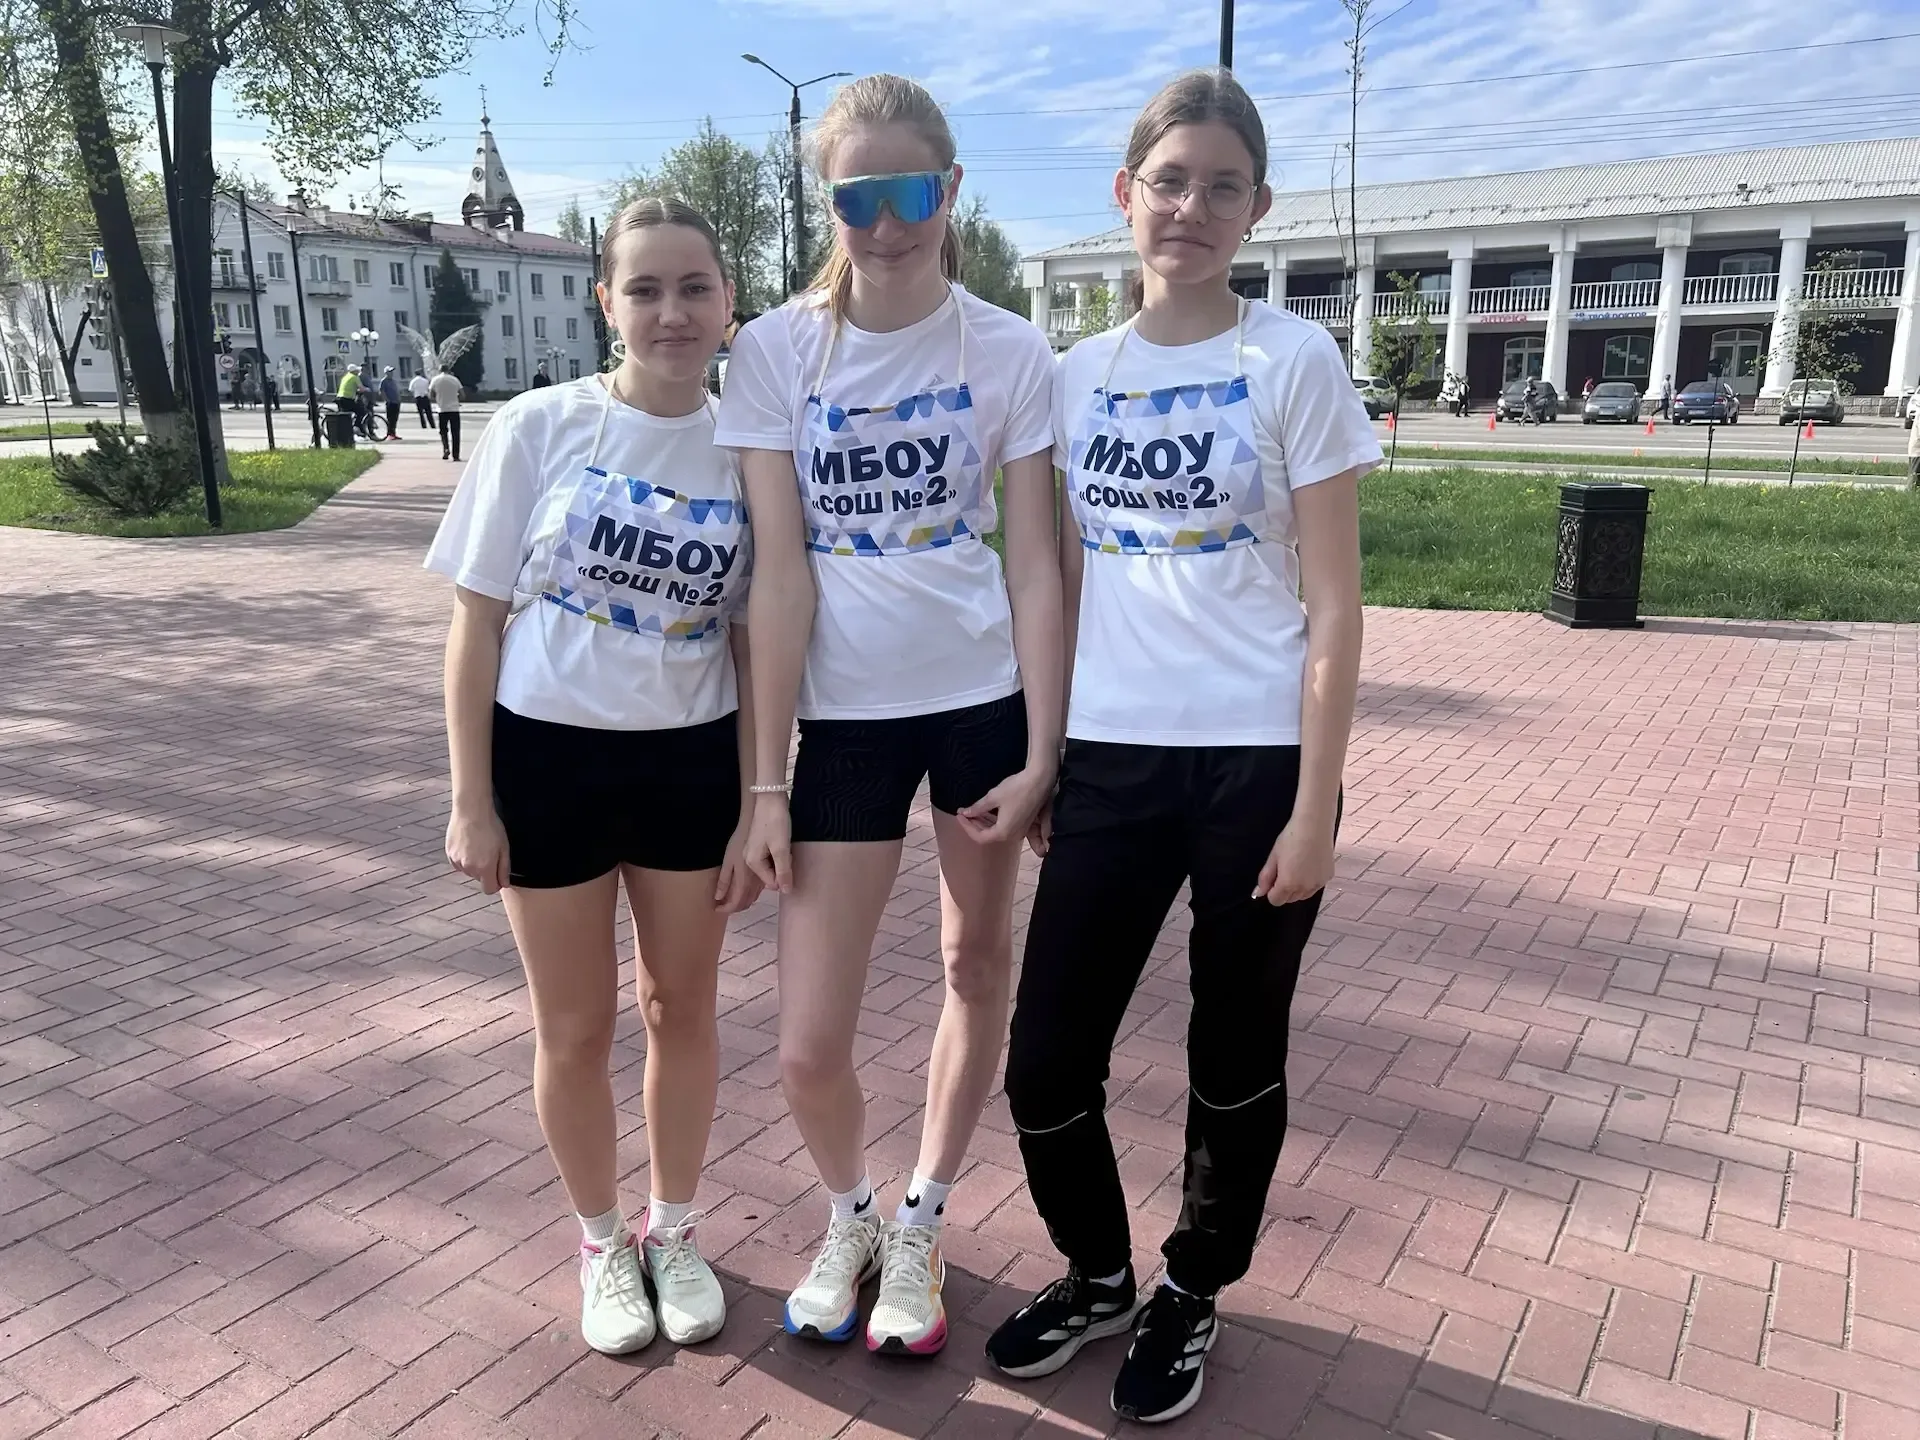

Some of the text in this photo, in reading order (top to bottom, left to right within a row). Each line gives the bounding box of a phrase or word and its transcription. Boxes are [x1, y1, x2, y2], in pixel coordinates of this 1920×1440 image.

[811, 433, 951, 485] МБОУ
[1083, 431, 1215, 480] МБОУ
[812, 491, 883, 516] «СОШ
[1079, 484, 1149, 509] «СОШ
[588, 514, 738, 580] МБОУ
[577, 564, 661, 595] «СОШ
